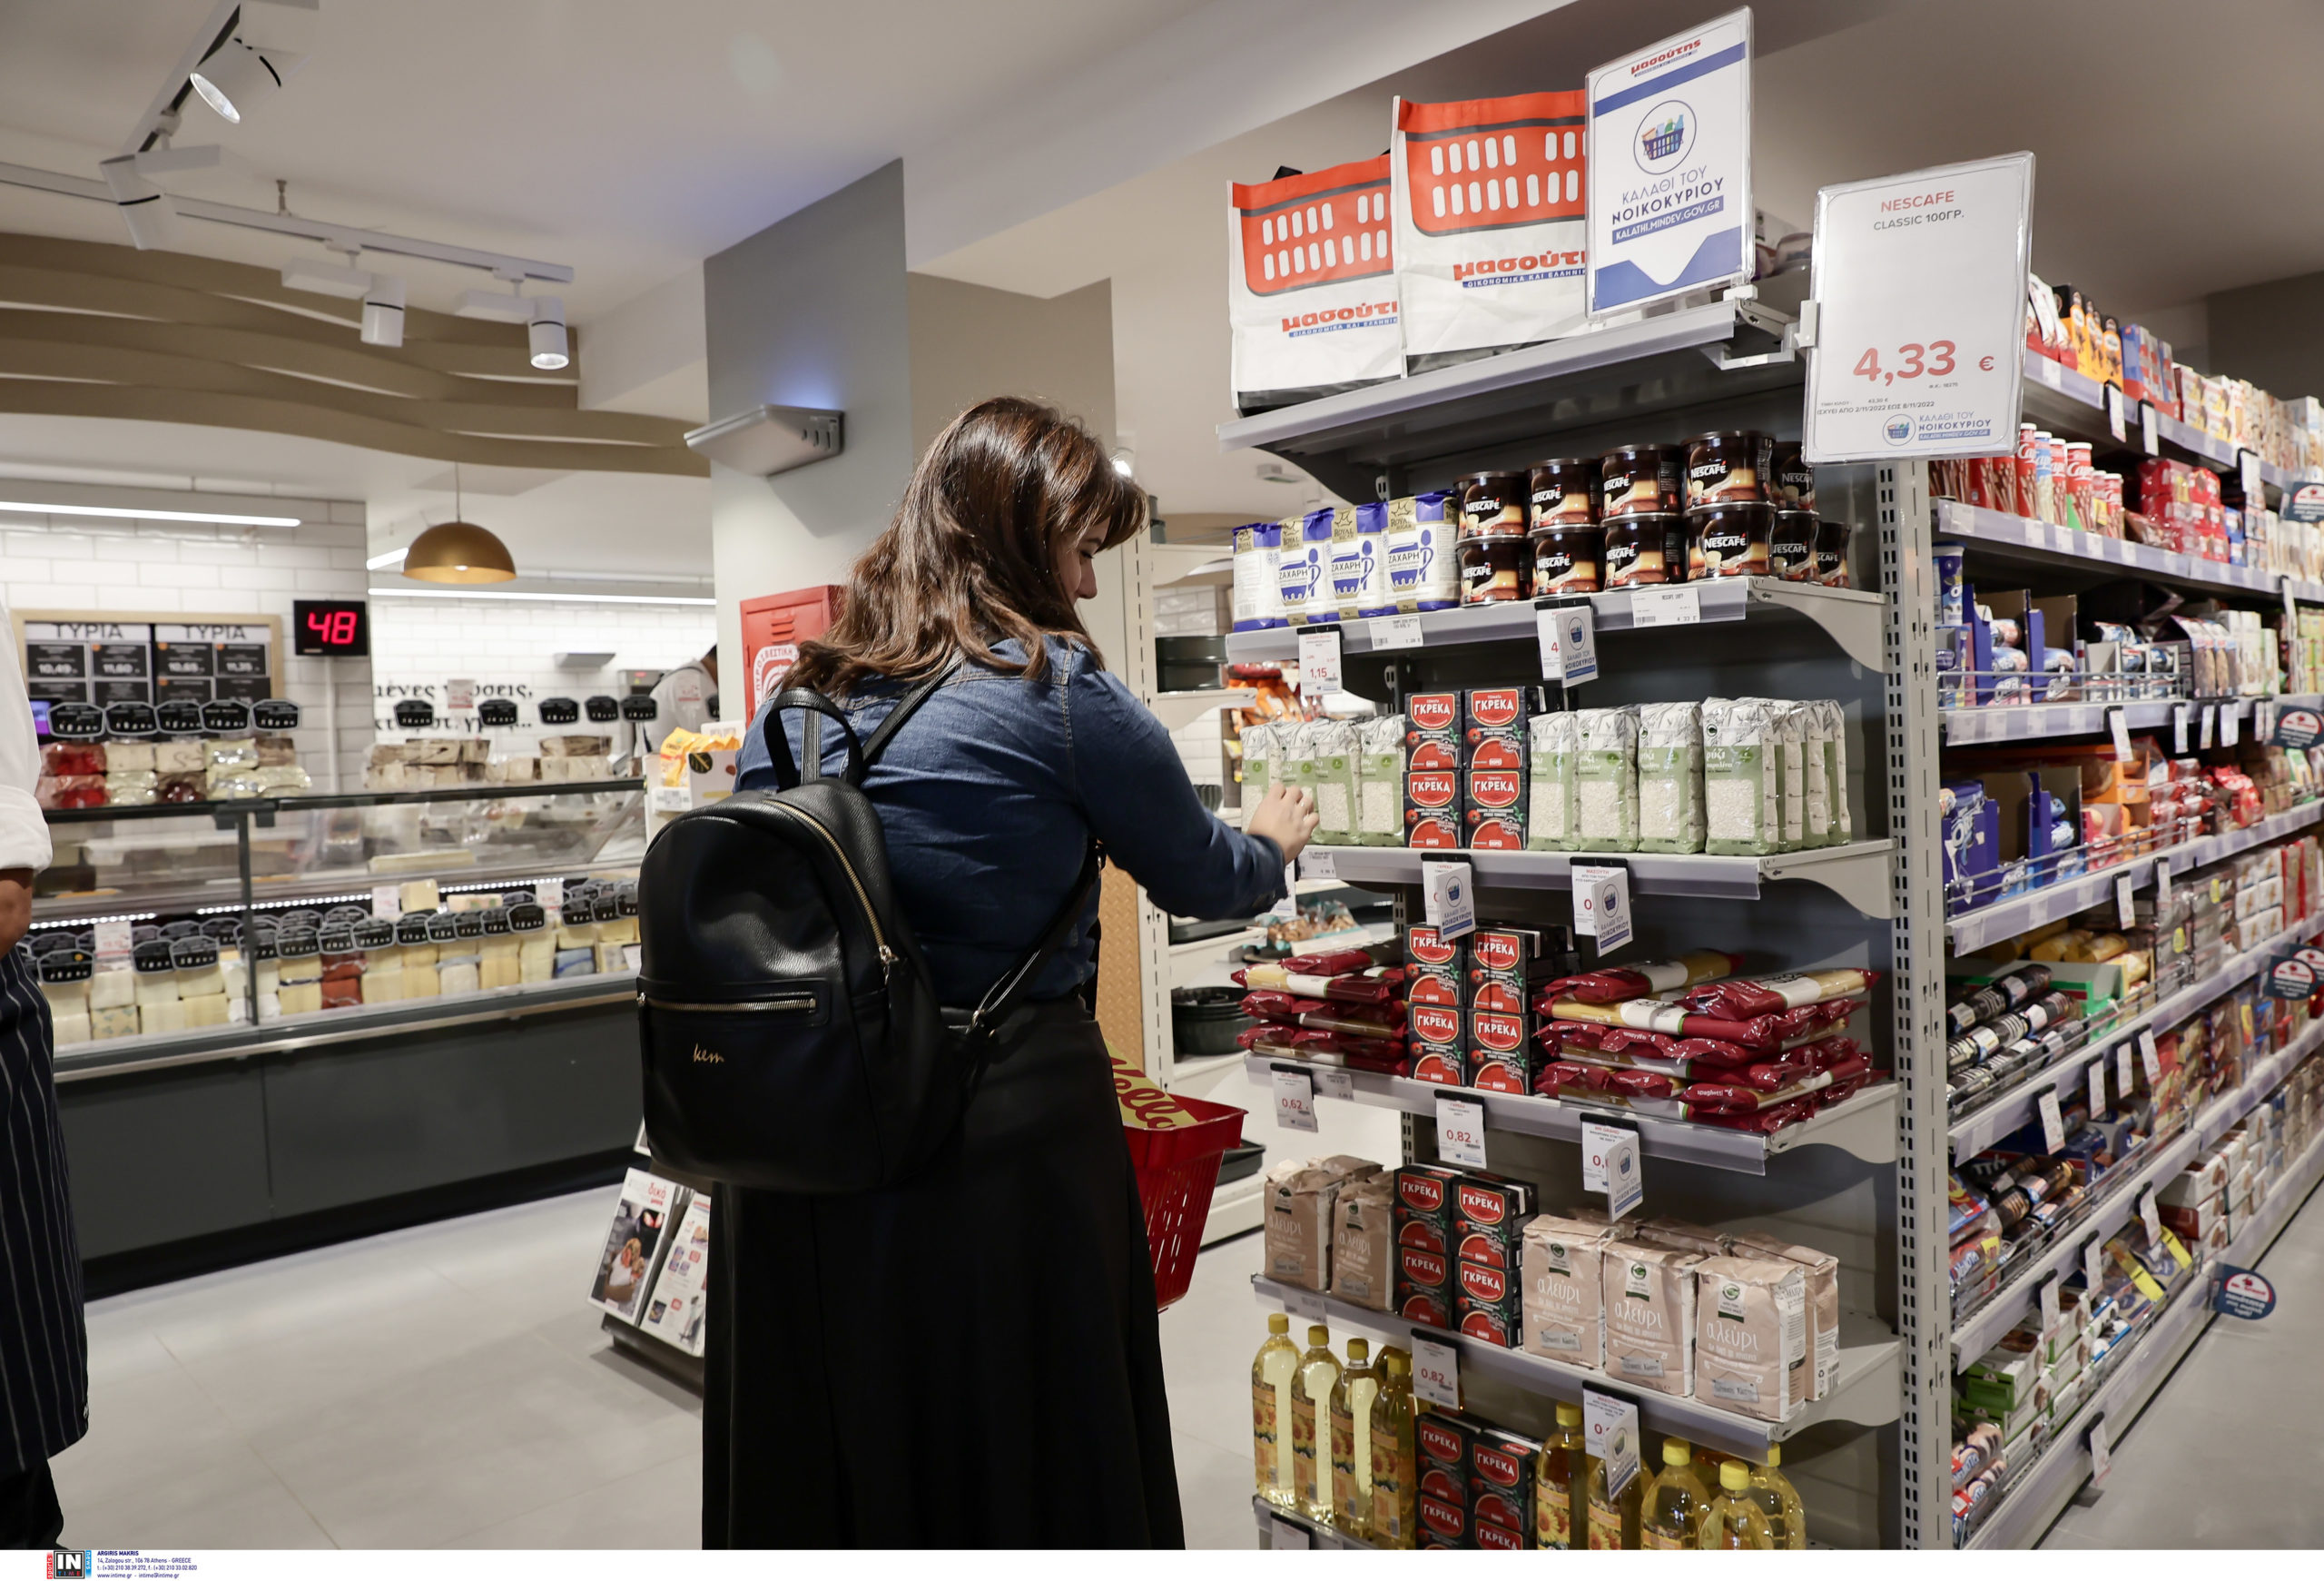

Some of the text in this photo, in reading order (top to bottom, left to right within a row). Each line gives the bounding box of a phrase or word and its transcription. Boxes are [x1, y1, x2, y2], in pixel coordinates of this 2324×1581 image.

[1630, 38, 1702, 75] μασούτης
[1622, 164, 1708, 205] ΚΑΛΑΘΙ ΤΟΥ
[1612, 177, 1724, 225] ΝΟΙΚΟΚΥΡΙΟΥ
[1880, 190, 1955, 213] NESCAFE
[1615, 198, 1720, 242] KALATHI.MINDEV.GOV.GR
[1874, 211, 1965, 232] CLASSIC 100ΓΡ.
[1467, 275, 1525, 289] ΟΙΚΟΝΟΜΙΚΑ
[1529, 273, 1545, 282] ΚΑΙ
[1293, 323, 1344, 337] ΟΙΚΟΝΟΜΙΚΑ
[1347, 321, 1361, 330] ΚΑΙ
[1853, 340, 1994, 387] 4,33 €
[1855, 405, 1886, 413] 2/11/2022
[1903, 400, 1935, 410] 8/11/2022
[1919, 410, 1974, 422] ΚΑΛΑΘΙ ΤΟΥ
[1918, 419, 1991, 431] ΝΟΙΚΟΚΥΡΙΟΥ
[1691, 460, 1727, 479] NESCAFÉ
[1531, 486, 1562, 503] NESCAFÉ
[1465, 497, 1501, 513] NESCAFÉ
[1334, 529, 1354, 538] ROYAL
[1705, 533, 1746, 549] NESCAFÉ
[1388, 551, 1420, 564] ΖΑΧΑΡΗ
[1606, 544, 1636, 560] NESCAFÉ
[1331, 561, 1361, 573] ΖΑΧΑΡΗ
[1537, 553, 1571, 569] NESCAFÉ
[1279, 568, 1308, 580] ΖΑΧΑΡΗ
[1462, 562, 1492, 578] NESCAFÉ
[307, 611, 359, 645] 48
[1310, 667, 1327, 679] 1,15
[1413, 703, 1451, 716] ΓΚΡΕΚΑ
[1474, 698, 1515, 713] ΓΚΡΕΚΑ
[1412, 781, 1452, 794] ΓΚΡΕΚΑ
[1474, 781, 1515, 793] ΓΚΡΕΚΑ
[1477, 942, 1515, 957] ΓΚΡΕΚΑ
[1417, 1015, 1454, 1031] ΓΚΡΕΚΑ
[1478, 1022, 1518, 1038] ΓΚΡΕΚΑ
[1697, 1090, 1724, 1098] spaghetti
[1282, 1098, 1303, 1110] 0,62
[1446, 1129, 1472, 1144] 0,82
[1402, 1181, 1439, 1201] ΓΚΡΕΚΑ
[1462, 1193, 1502, 1212] ΓΚΡΕΚΑ
[1405, 1256, 1442, 1276] ΓΚΡΕΚΑ
[1463, 1271, 1502, 1291] ΓΚΡΕΚΑ
[1537, 1276, 1581, 1304] αλεύρι
[1614, 1299, 1663, 1329] αλεύρι
[1707, 1319, 1758, 1351] αλεύρι
[1420, 1368, 1445, 1385] 0,82
[1423, 1430, 1458, 1454] ΓΚΡΕΚΑ
[1477, 1453, 1515, 1477] ΓΚΡΕΚΑ
[1423, 1504, 1460, 1528] ΓΚΡΕΚΑ
